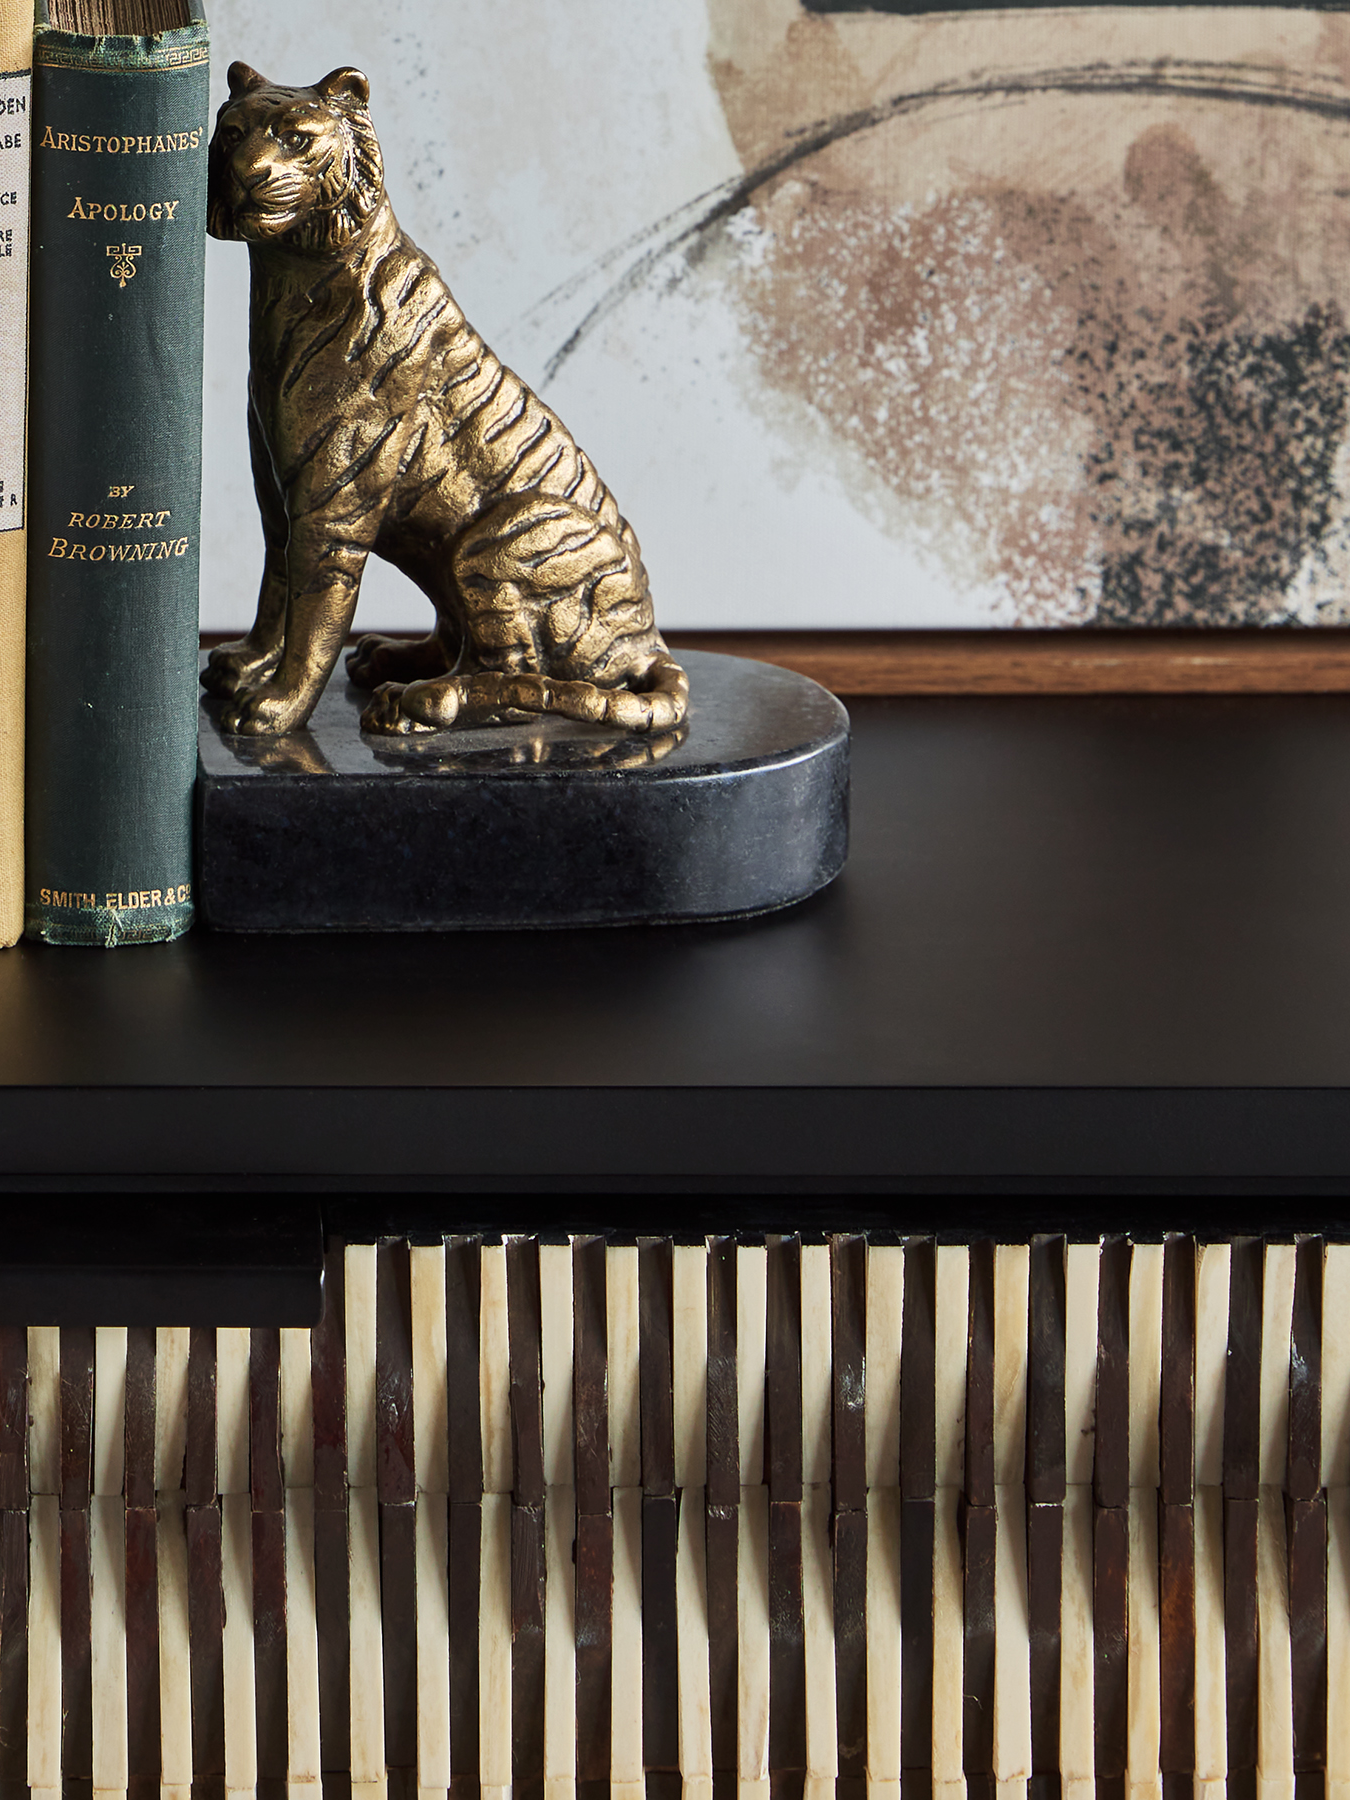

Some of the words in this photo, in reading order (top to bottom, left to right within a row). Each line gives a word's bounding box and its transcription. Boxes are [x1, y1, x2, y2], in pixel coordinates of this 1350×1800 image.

[107, 485, 135, 498] BY
[67, 510, 171, 530] ROBERT
[105, 888, 162, 910] ELDER
